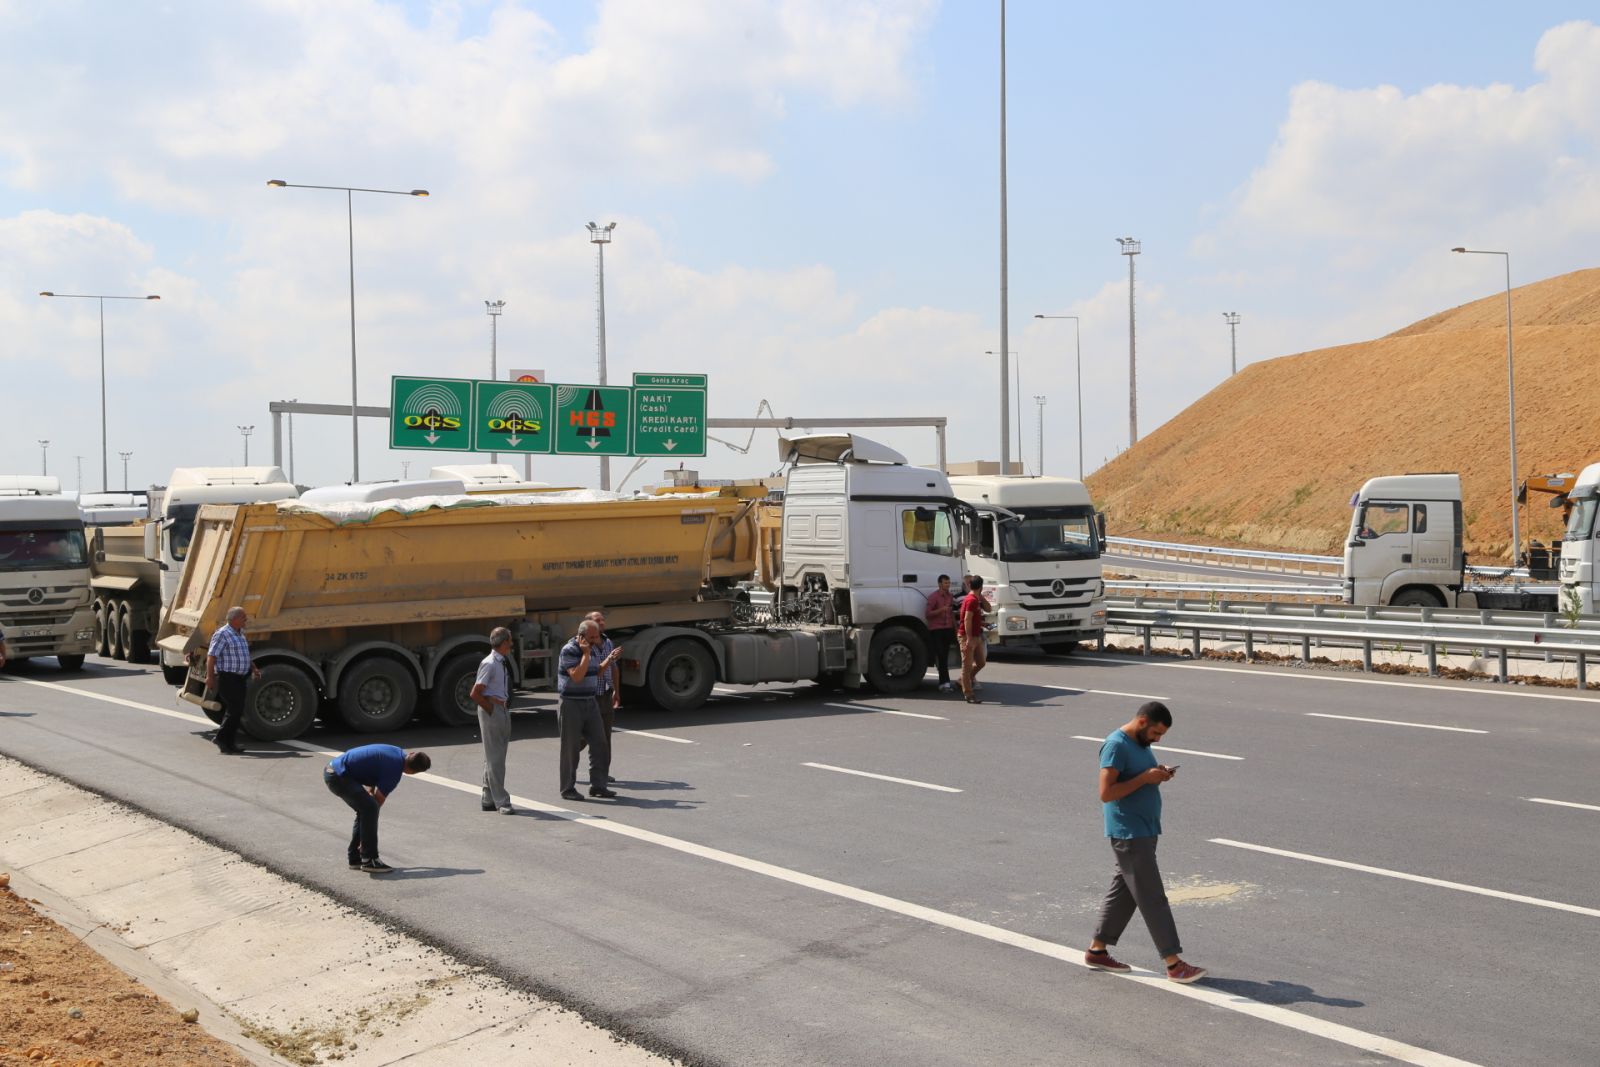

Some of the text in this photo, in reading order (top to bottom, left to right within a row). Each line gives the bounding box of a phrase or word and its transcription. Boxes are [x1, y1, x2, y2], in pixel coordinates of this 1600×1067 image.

[642, 395, 673, 403] NAKİT
[640, 404, 667, 412] (Cash)
[404, 415, 462, 428] OGS
[569, 410, 616, 427] HGS
[642, 415, 697, 424] KREDİ KARTI
[488, 418, 541, 431] OGS
[640, 425, 671, 433] (Credit
